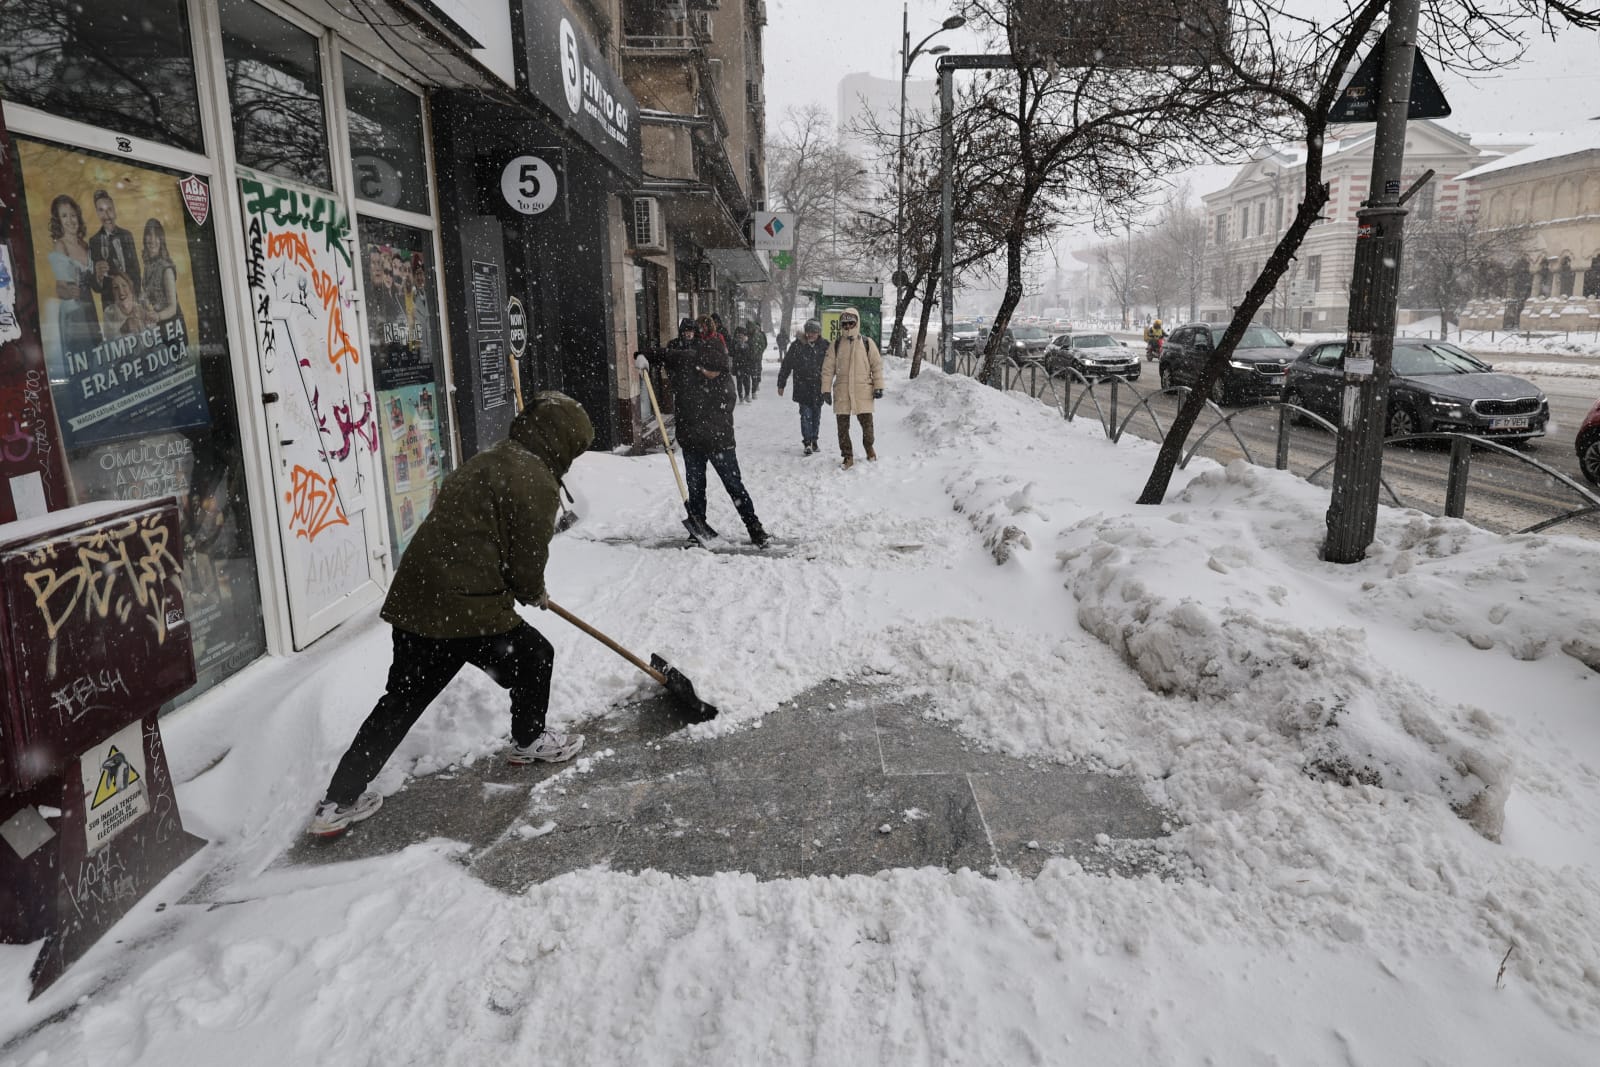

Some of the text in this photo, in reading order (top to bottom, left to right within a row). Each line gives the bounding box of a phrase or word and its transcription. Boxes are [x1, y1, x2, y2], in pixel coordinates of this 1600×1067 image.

[567, 32, 577, 87] 5
[616, 102, 628, 132] GO
[185, 179, 207, 197] ABA
[518, 164, 541, 199] 5
[518, 200, 544, 212] to go
[510, 314, 522, 326] NOW
[65, 319, 184, 375] ÎN TIMP CE EA
[511, 328, 525, 341] OPEN
[81, 368, 119, 399] ERA
[120, 358, 144, 381] PE
[146, 338, 188, 372] DUCĂ
[100, 438, 193, 470] OMUL CARE
[116, 469, 128, 487] A
[102, 803, 133, 829] PERICOL DE
